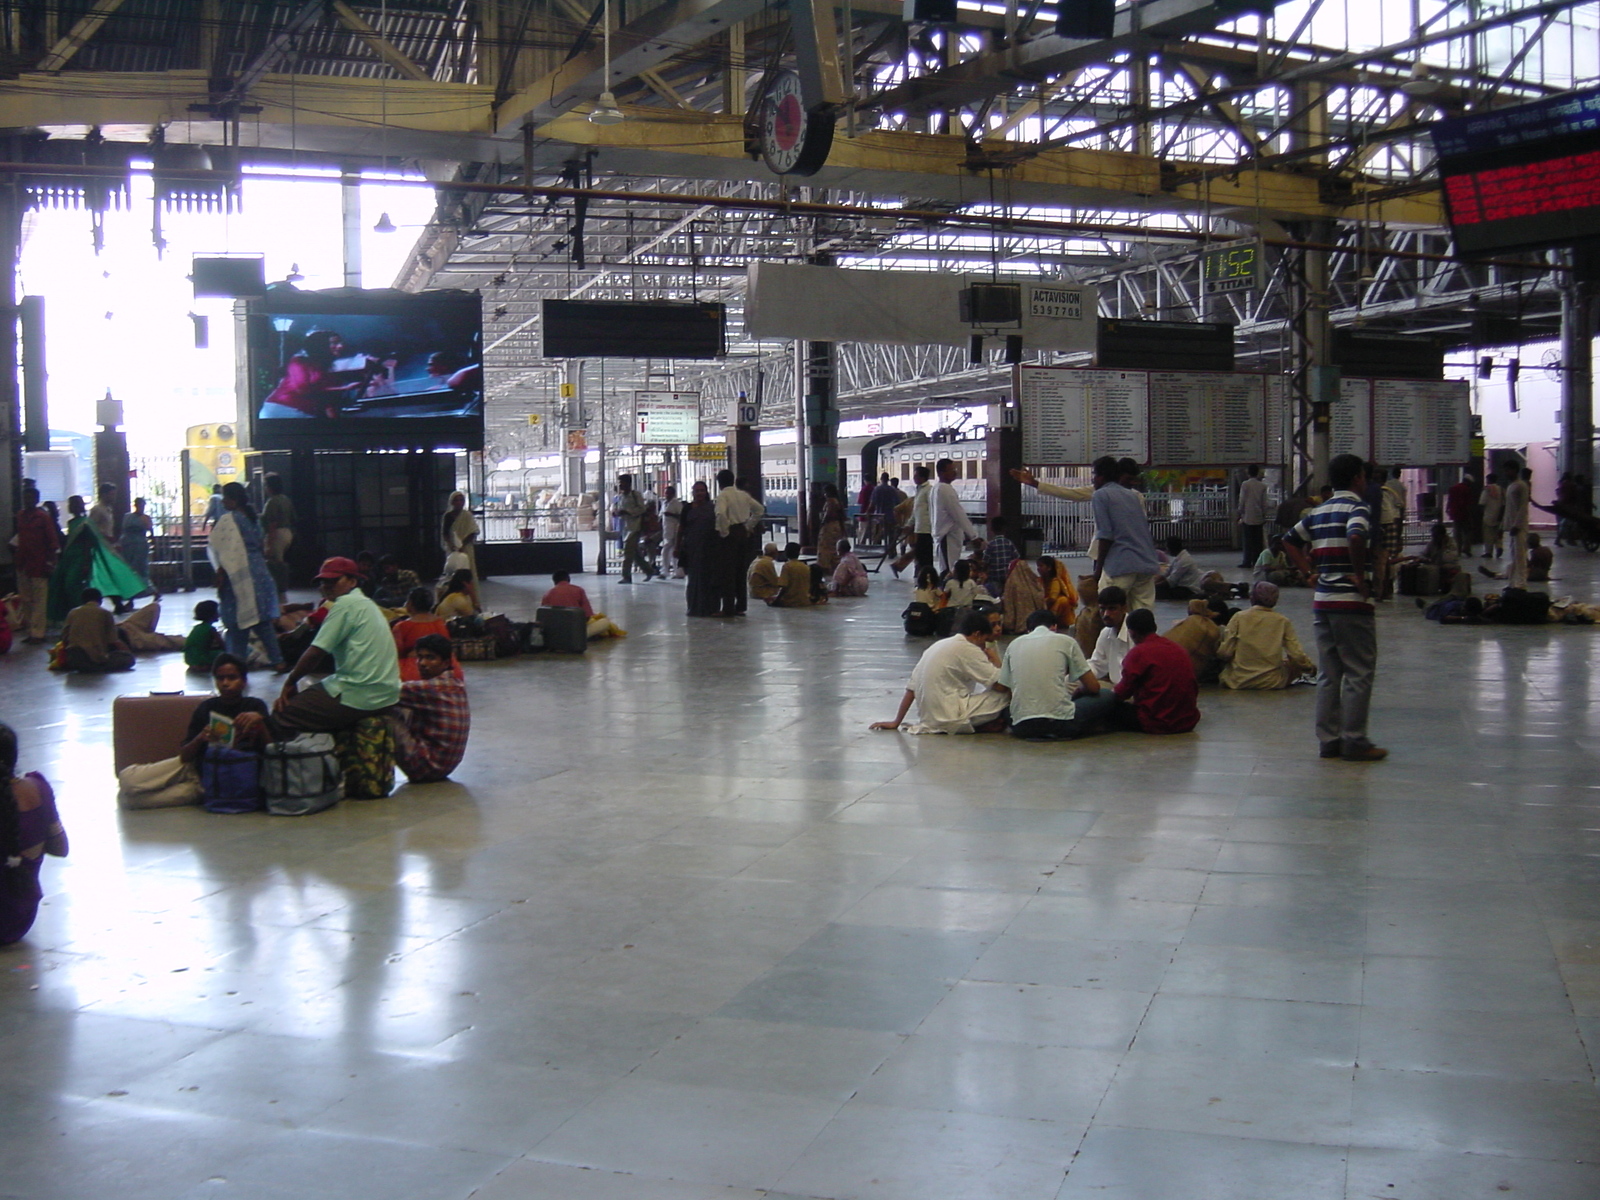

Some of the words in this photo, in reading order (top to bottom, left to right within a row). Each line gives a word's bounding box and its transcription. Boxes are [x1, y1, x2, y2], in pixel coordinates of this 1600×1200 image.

[767, 121, 773, 137] 9
[769, 140, 776, 155] 8
[794, 143, 800, 160] 5
[777, 150, 783, 165] 7
[785, 152, 792, 168] 6
[1205, 249, 1254, 279] 11:52
[1219, 277, 1254, 290] TITAN
[1033, 290, 1080, 304] ACTAVISION
[565, 385, 571, 397] 1
[532, 415, 538, 425] 2
[740, 406, 756, 423] 10
[1004, 409, 1014, 424] 11
